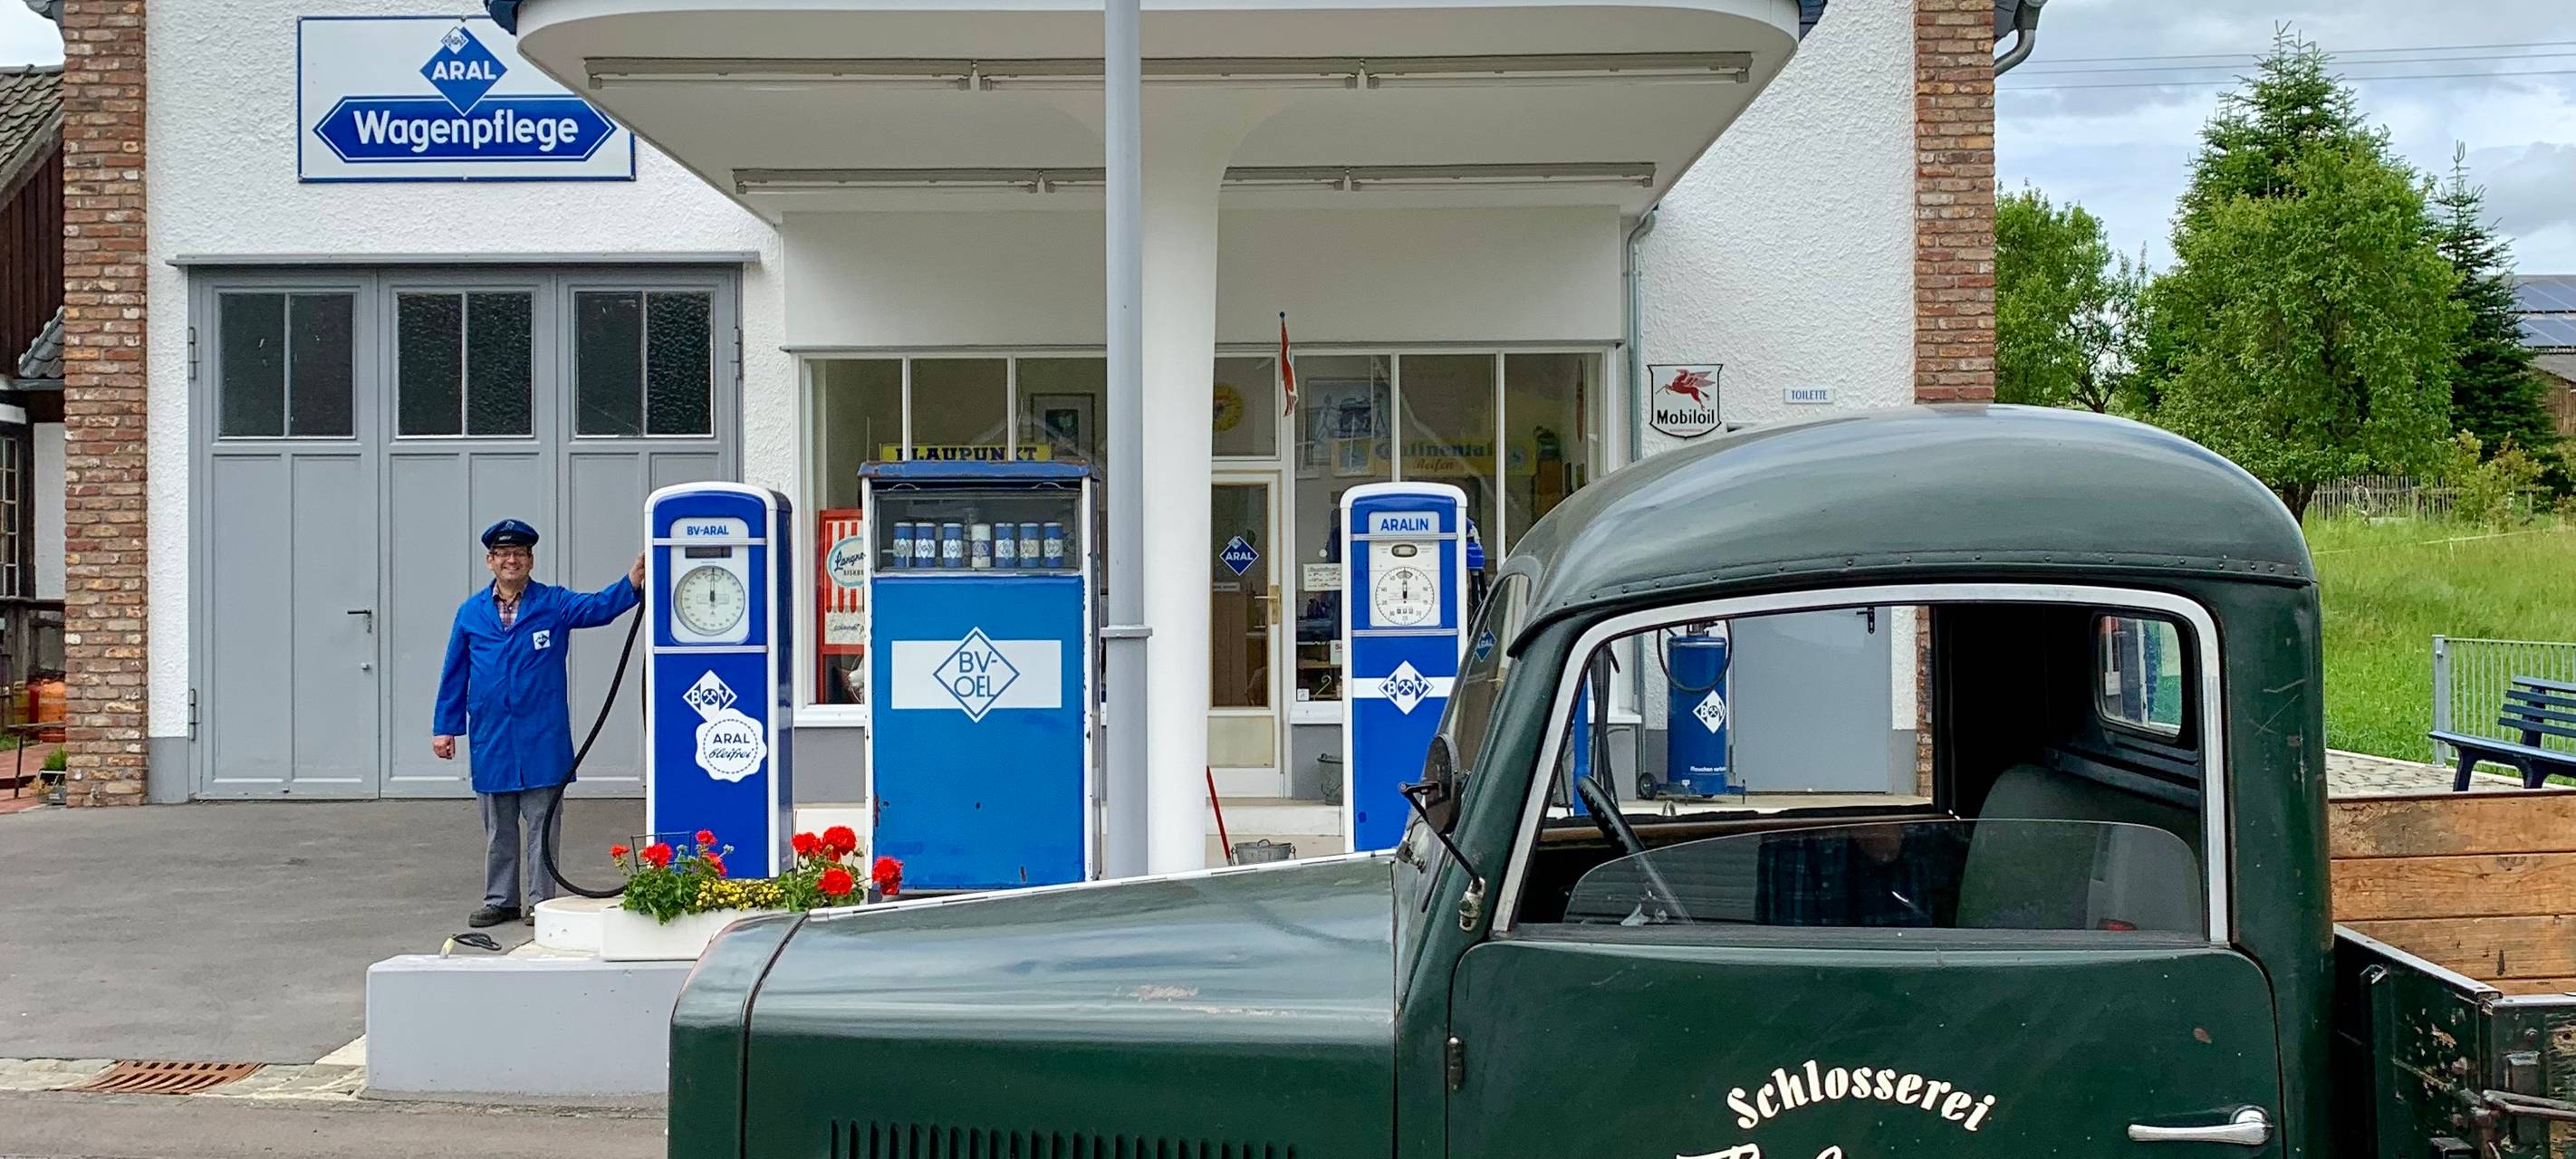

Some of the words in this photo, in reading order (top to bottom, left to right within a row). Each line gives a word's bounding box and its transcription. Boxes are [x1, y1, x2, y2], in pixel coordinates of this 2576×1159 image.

[430, 60, 497, 81] ARAL
[353, 109, 579, 153] Wagenpflege
[1791, 389, 1827, 400] TOILETTE
[1657, 409, 1715, 425] Mobiloil
[687, 525, 729, 536] BV-ARAL
[1380, 518, 1428, 532] ARALIN
[1225, 551, 1254, 560] ARAL
[959, 651, 997, 674] BV-
[954, 675, 996, 698] OEL
[713, 733, 750, 744] ARAL
[708, 747, 755, 761] bleifrei
[1726, 1059, 1995, 1132] Schlosserei
